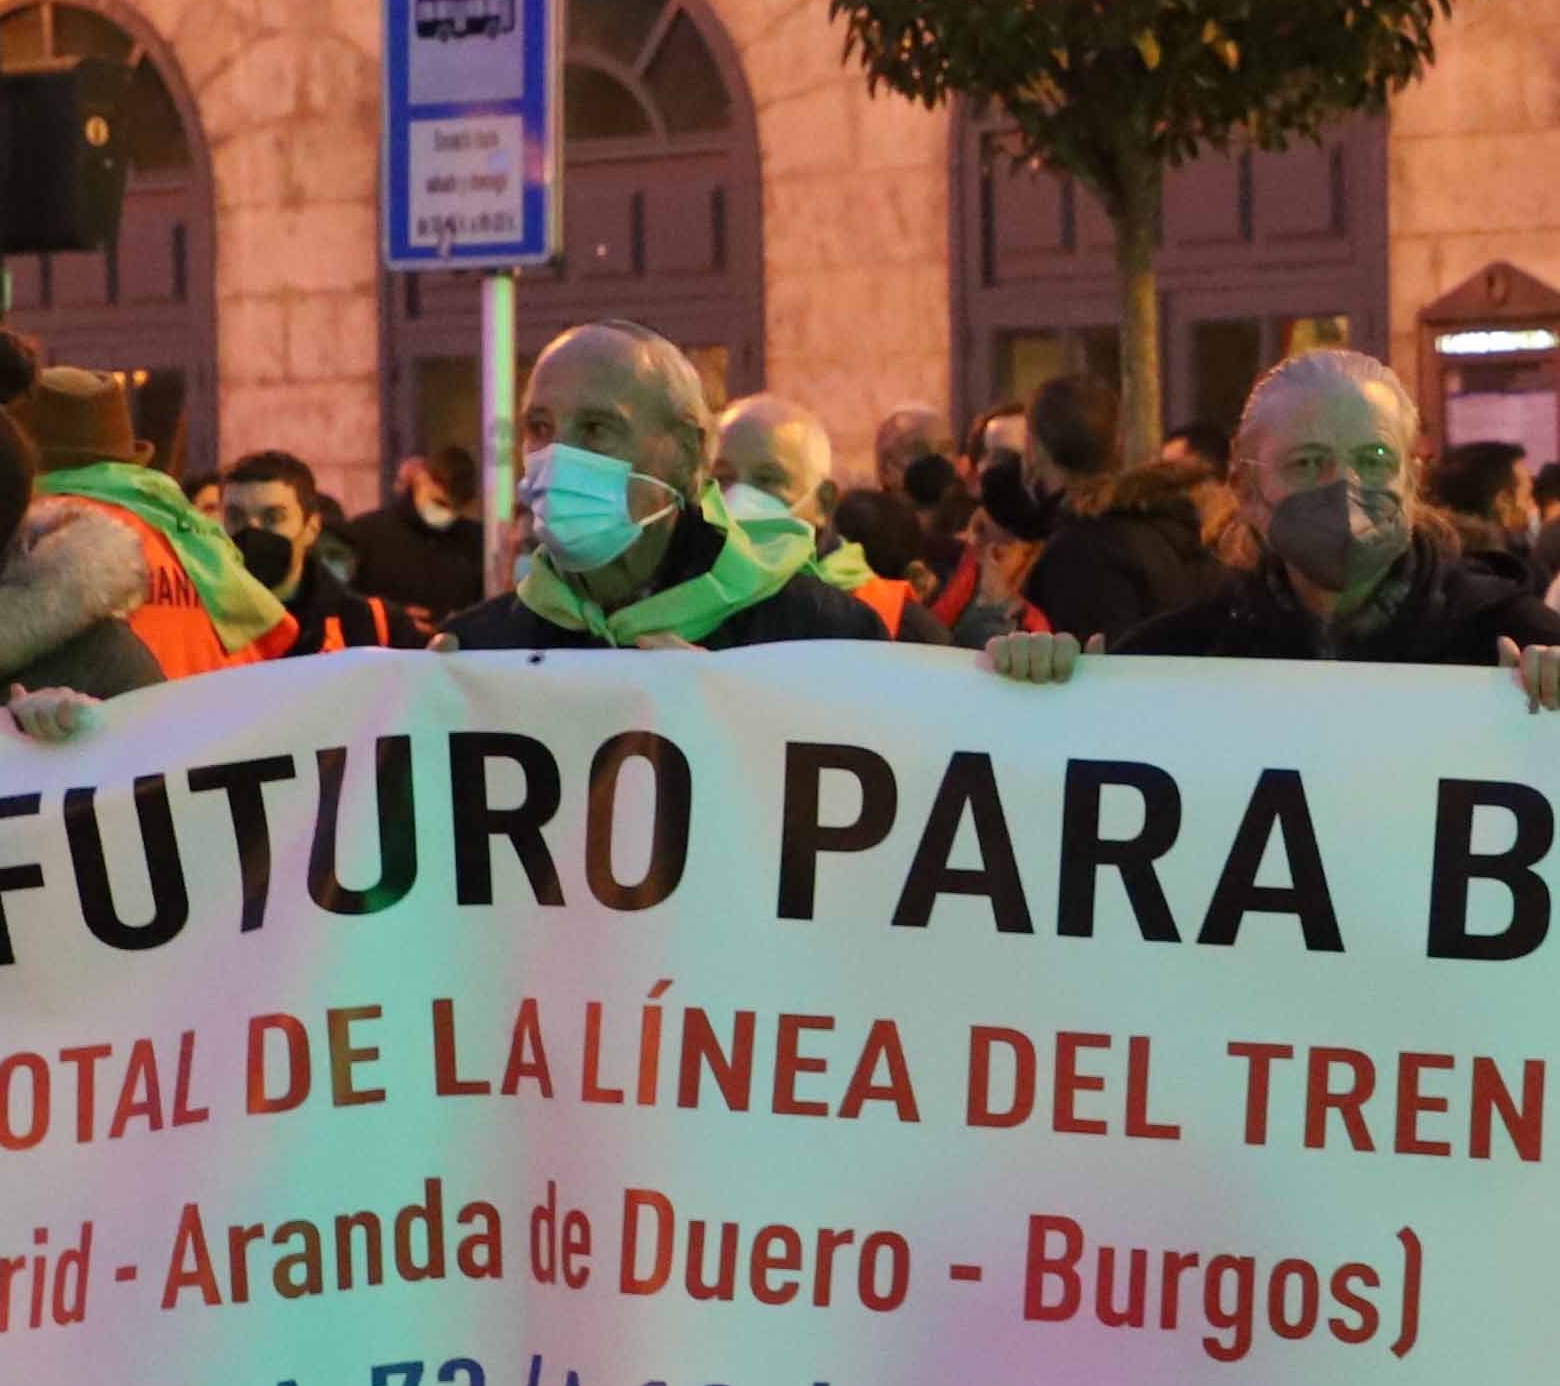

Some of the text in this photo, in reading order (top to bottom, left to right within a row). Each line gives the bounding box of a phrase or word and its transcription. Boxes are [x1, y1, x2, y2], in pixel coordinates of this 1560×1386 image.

[774, 739, 1348, 955] PARA
[244, 1003, 388, 1116] DE
[430, 996, 556, 1101] LA
[580, 978, 922, 1125] LÍNEA
[964, 1023, 1182, 1142] DEL
[1225, 1040, 1547, 1164] TREN
[159, 1175, 505, 1311] Aranda
[528, 1178, 593, 1292] de
[618, 1187, 912, 1314] Duero
[1022, 1213, 1424, 1364] Burgos)
